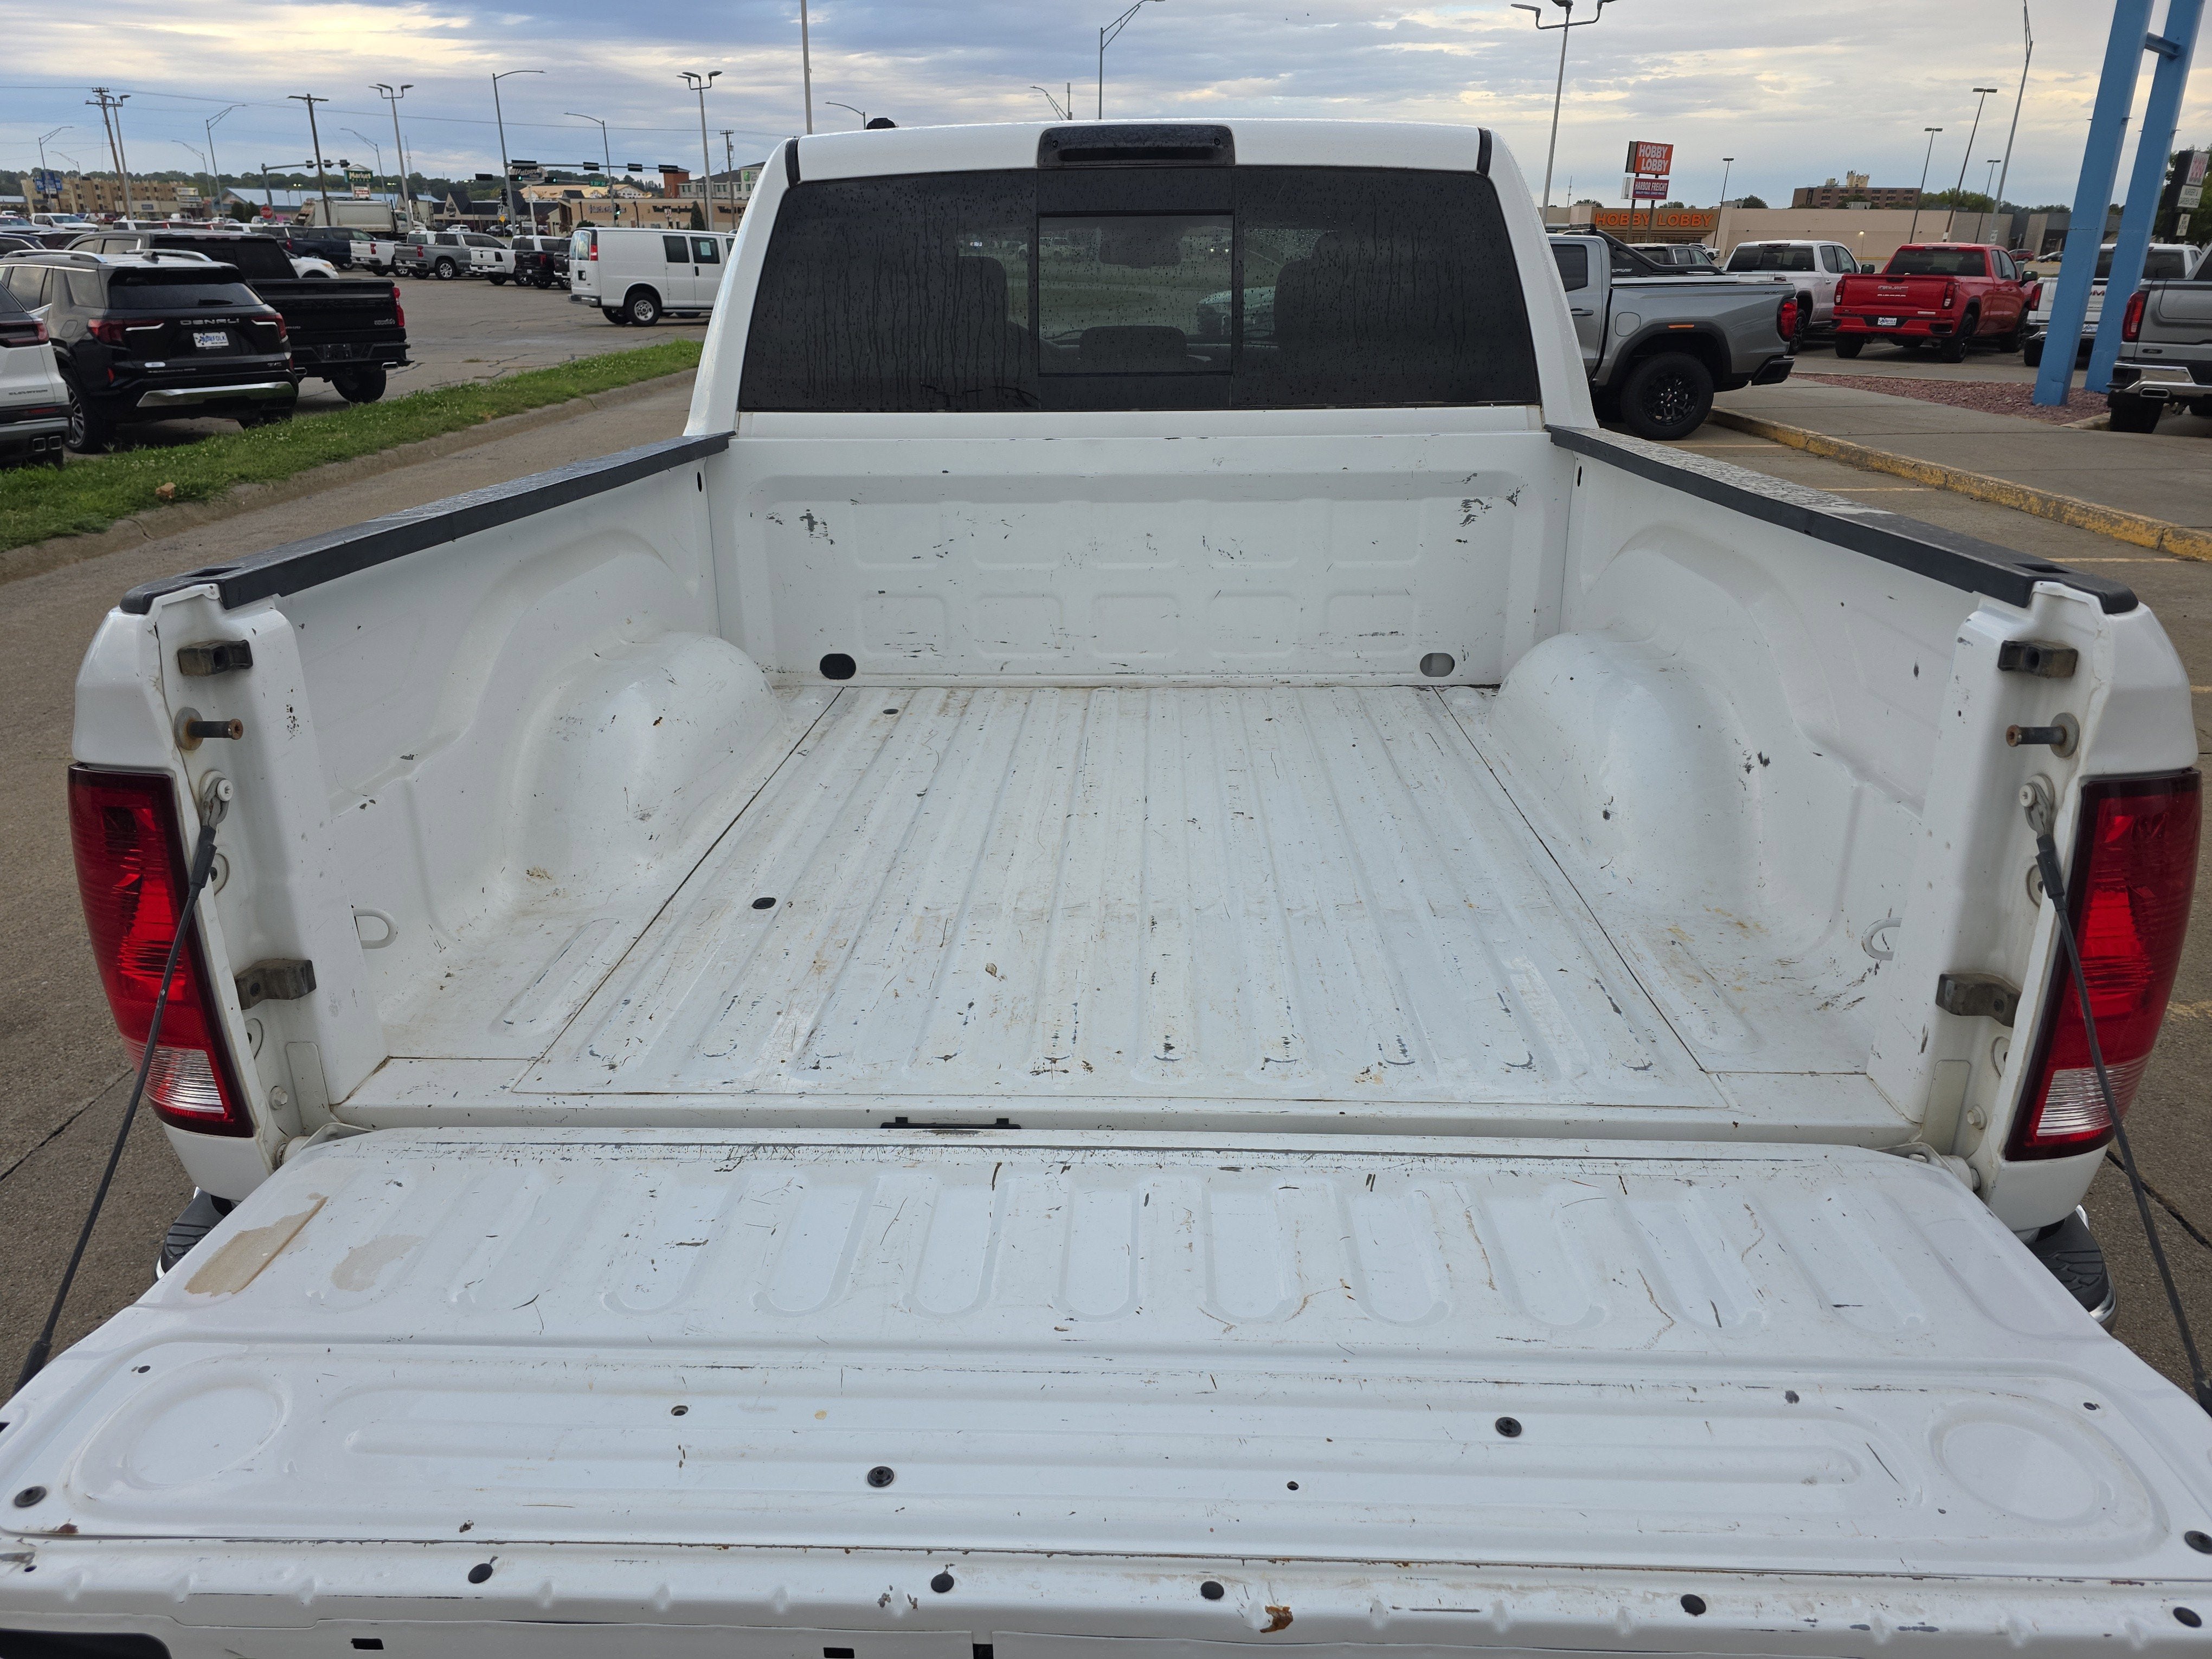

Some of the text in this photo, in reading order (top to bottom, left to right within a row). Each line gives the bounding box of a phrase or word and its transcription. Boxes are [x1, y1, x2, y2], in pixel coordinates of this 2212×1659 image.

[1638, 144, 1668, 158] HOBBY
[1641, 158, 1669, 172] LOBBY
[1635, 181, 1668, 192] HARBOR FREIGHT
[1596, 213, 1714, 227] HOBBY LOBBY
